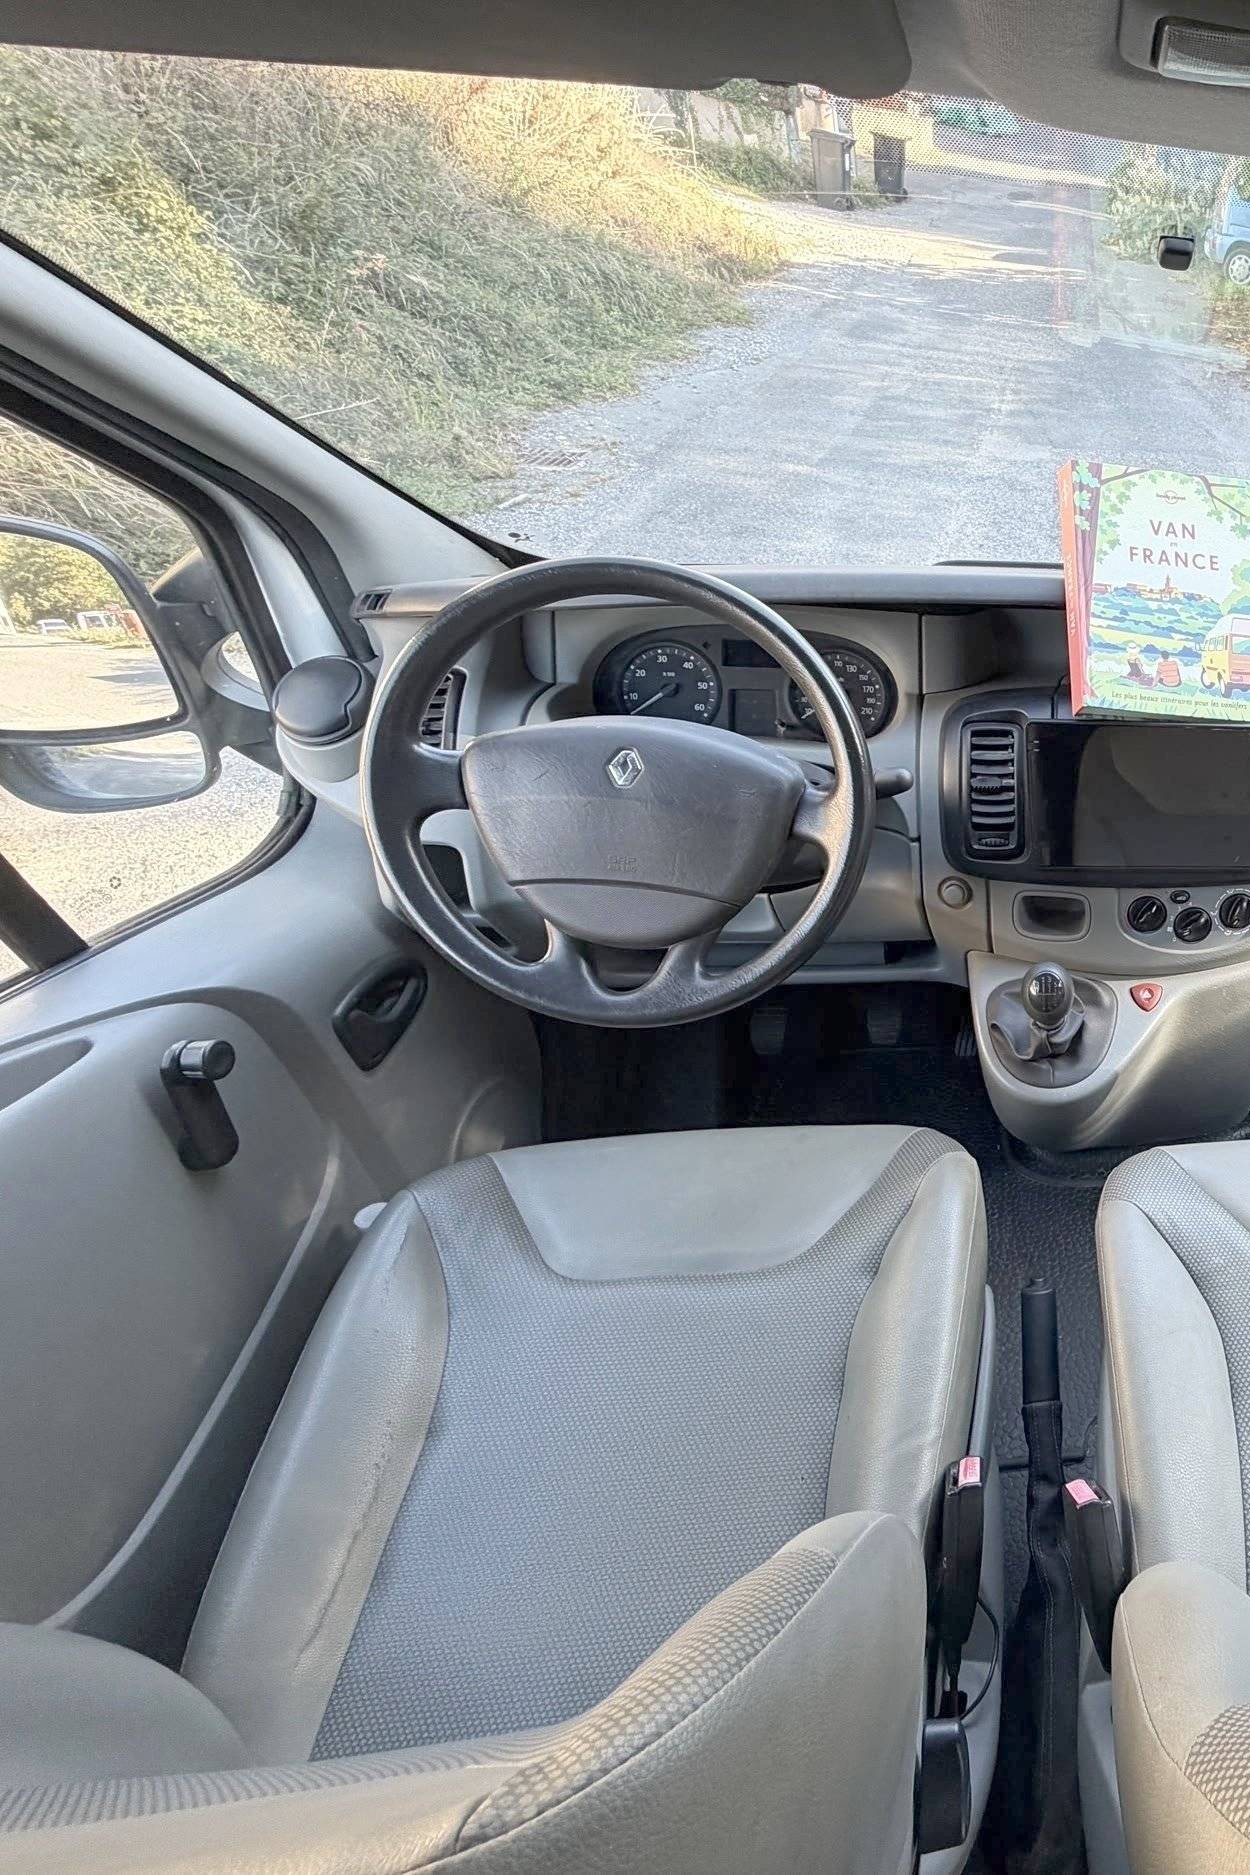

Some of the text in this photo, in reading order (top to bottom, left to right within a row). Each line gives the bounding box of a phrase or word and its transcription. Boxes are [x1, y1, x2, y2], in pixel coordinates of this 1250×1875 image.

[1149, 519, 1196, 540] VAN
[1129, 545, 1220, 572] FRANCE
[656, 655, 668, 663] 30
[682, 661, 694, 669] 40
[846, 664, 857, 673] 130
[635, 669, 646, 677] 20
[697, 681, 708, 690] 50
[862, 685, 875, 693] 170
[629, 692, 639, 700] 10
[1111, 690, 1123, 699] Les
[694, 703, 706, 711] 60
[861, 706, 873, 715] 210
